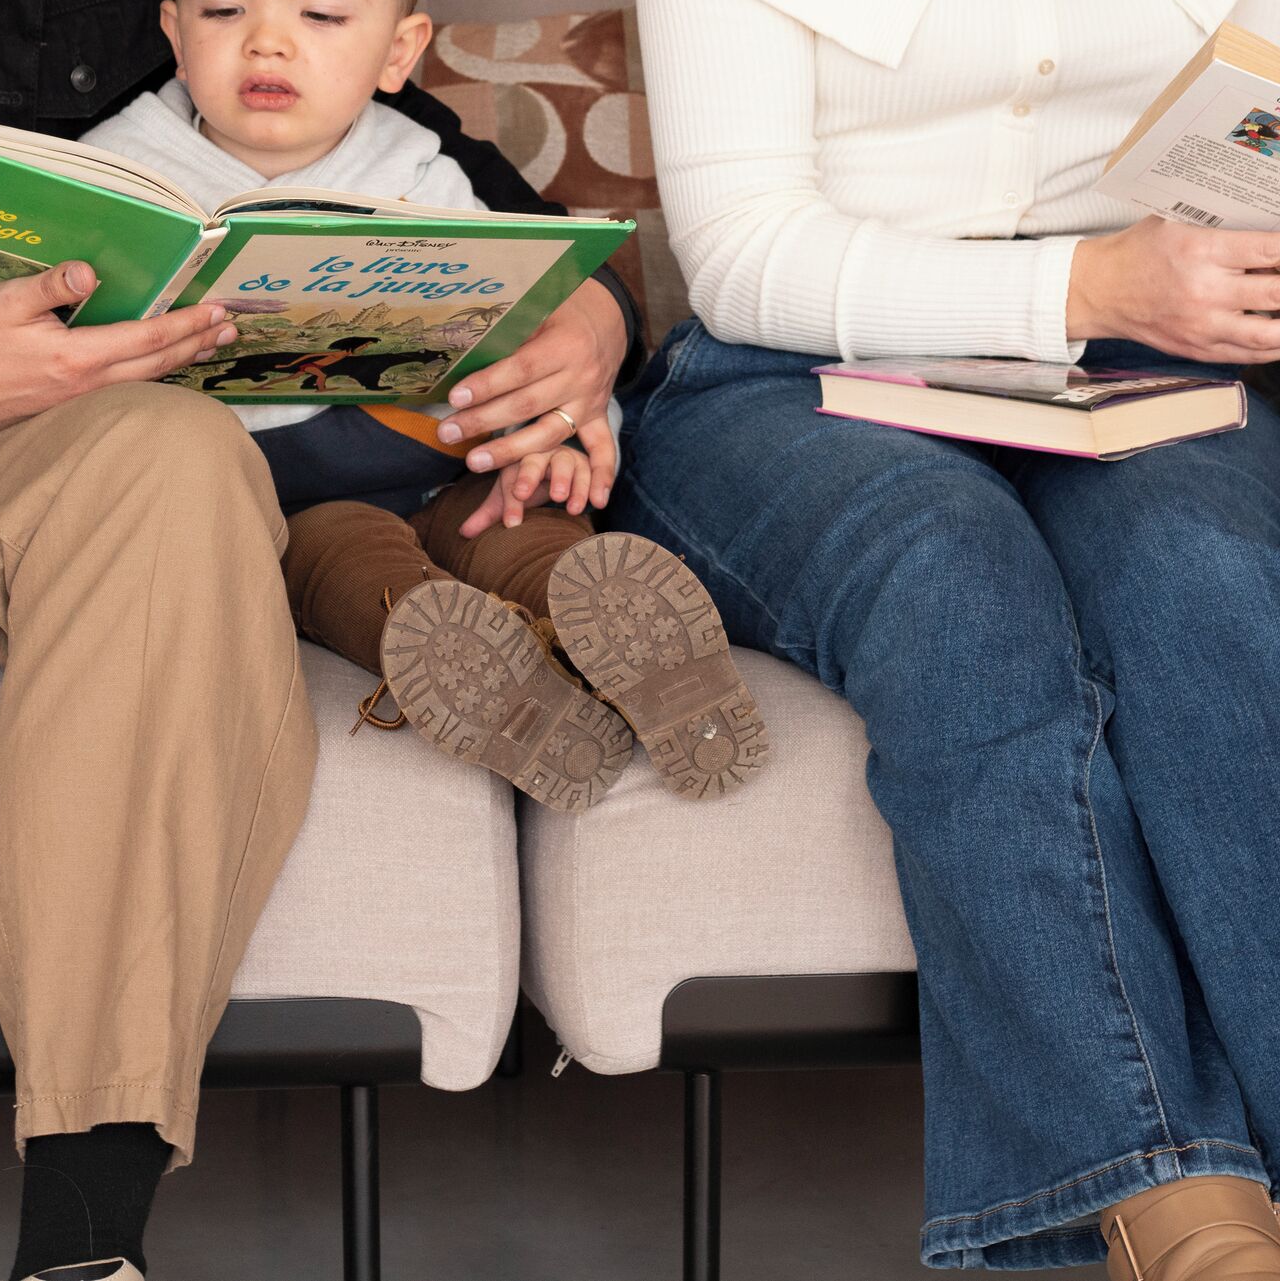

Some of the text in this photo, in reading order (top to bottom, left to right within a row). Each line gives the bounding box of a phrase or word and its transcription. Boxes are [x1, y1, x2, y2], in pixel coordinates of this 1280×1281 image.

[308, 254, 470, 276] le livre
[238, 273, 505, 300] de la jungle
